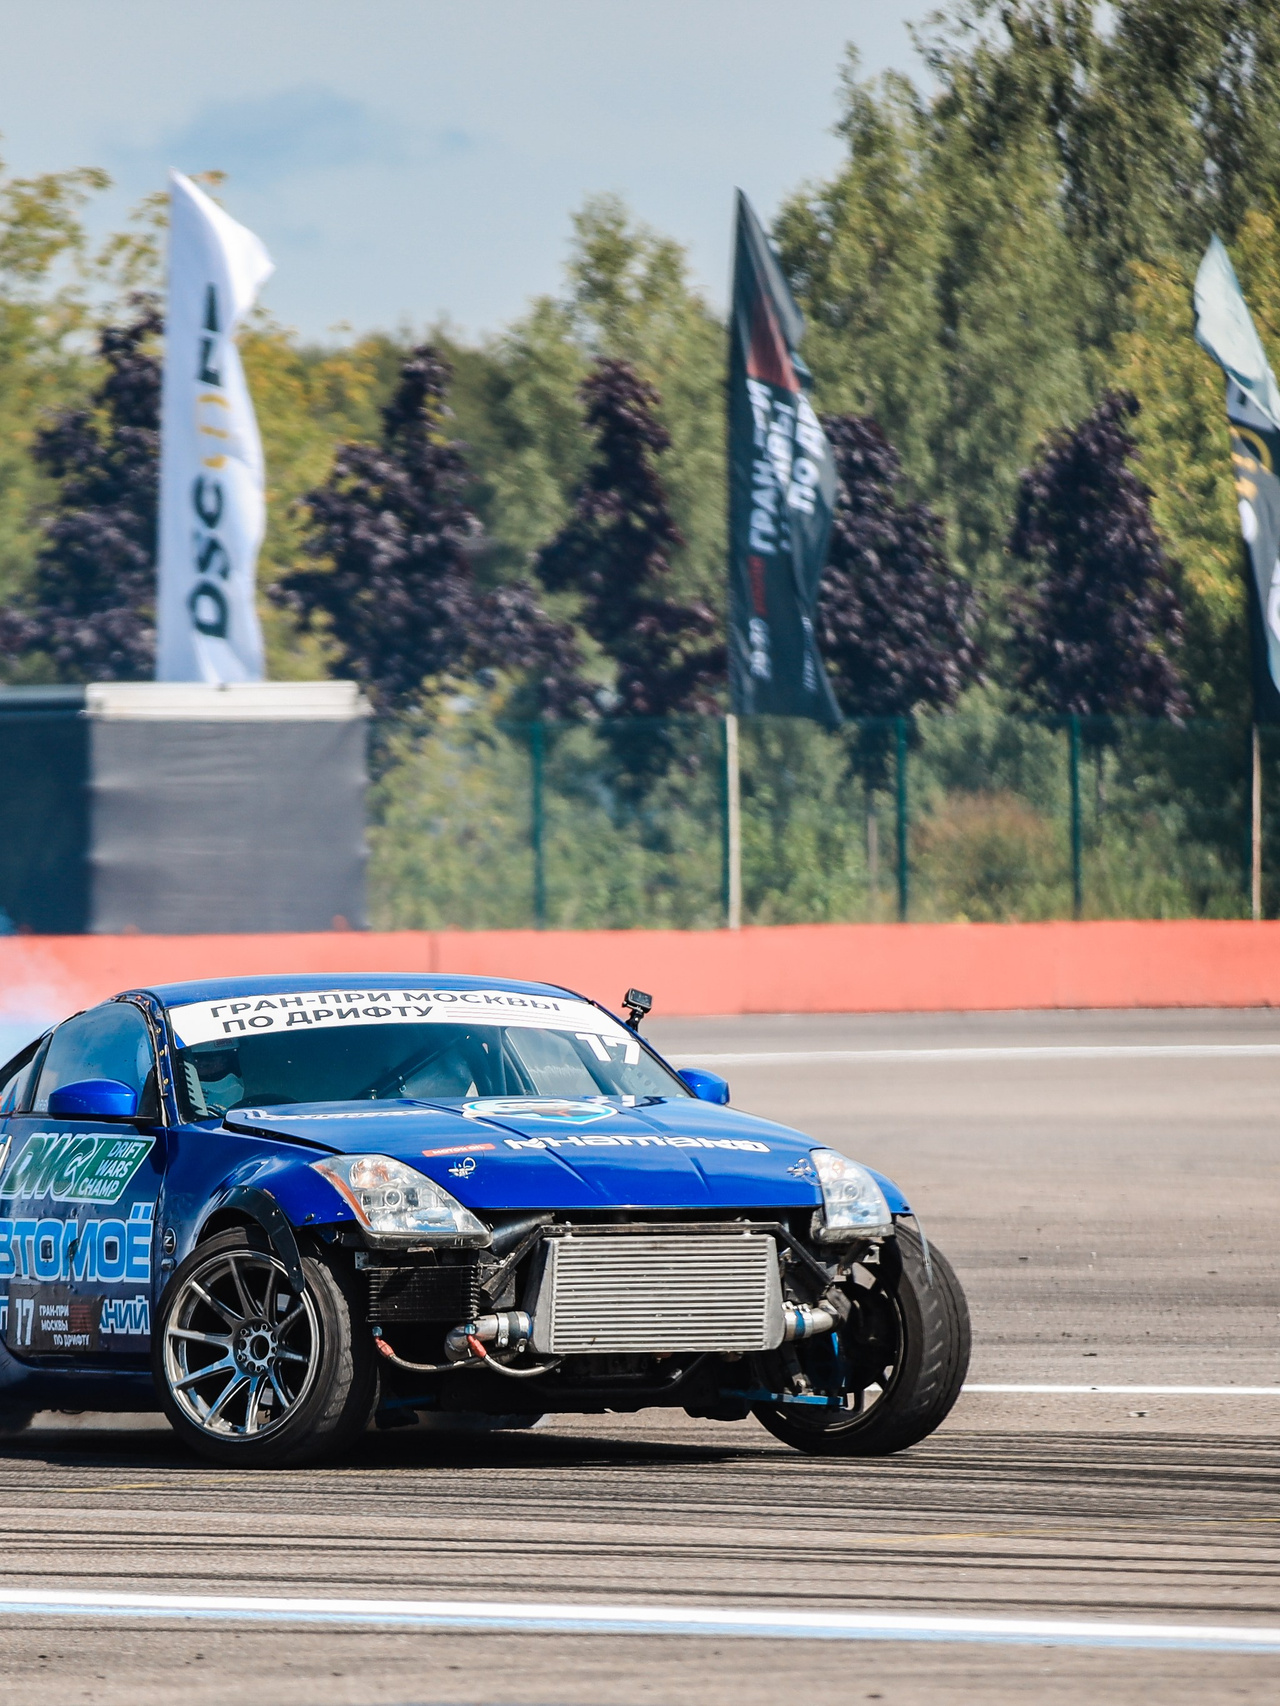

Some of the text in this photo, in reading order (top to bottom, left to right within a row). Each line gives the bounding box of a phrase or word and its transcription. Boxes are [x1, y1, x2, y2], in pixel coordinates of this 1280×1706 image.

[210, 992, 561, 1018] ГРАН-ПРИ МОСКВЫ
[222, 1005, 434, 1033] ПО ДРИФТУ
[574, 1032, 641, 1065] 17
[107, 1140, 147, 1159] DRIFT
[95, 1159, 134, 1179] WARS
[78, 1177, 120, 1197] CHAMP
[39, 1304, 70, 1317] ГРАН-ПРИ
[99, 1295, 152, 1335] НИЙ
[15, 1298, 35, 1346] 17
[41, 1319, 69, 1332] МОСКВЫ
[53, 1333, 91, 1348] ПО ДРИФТУ
